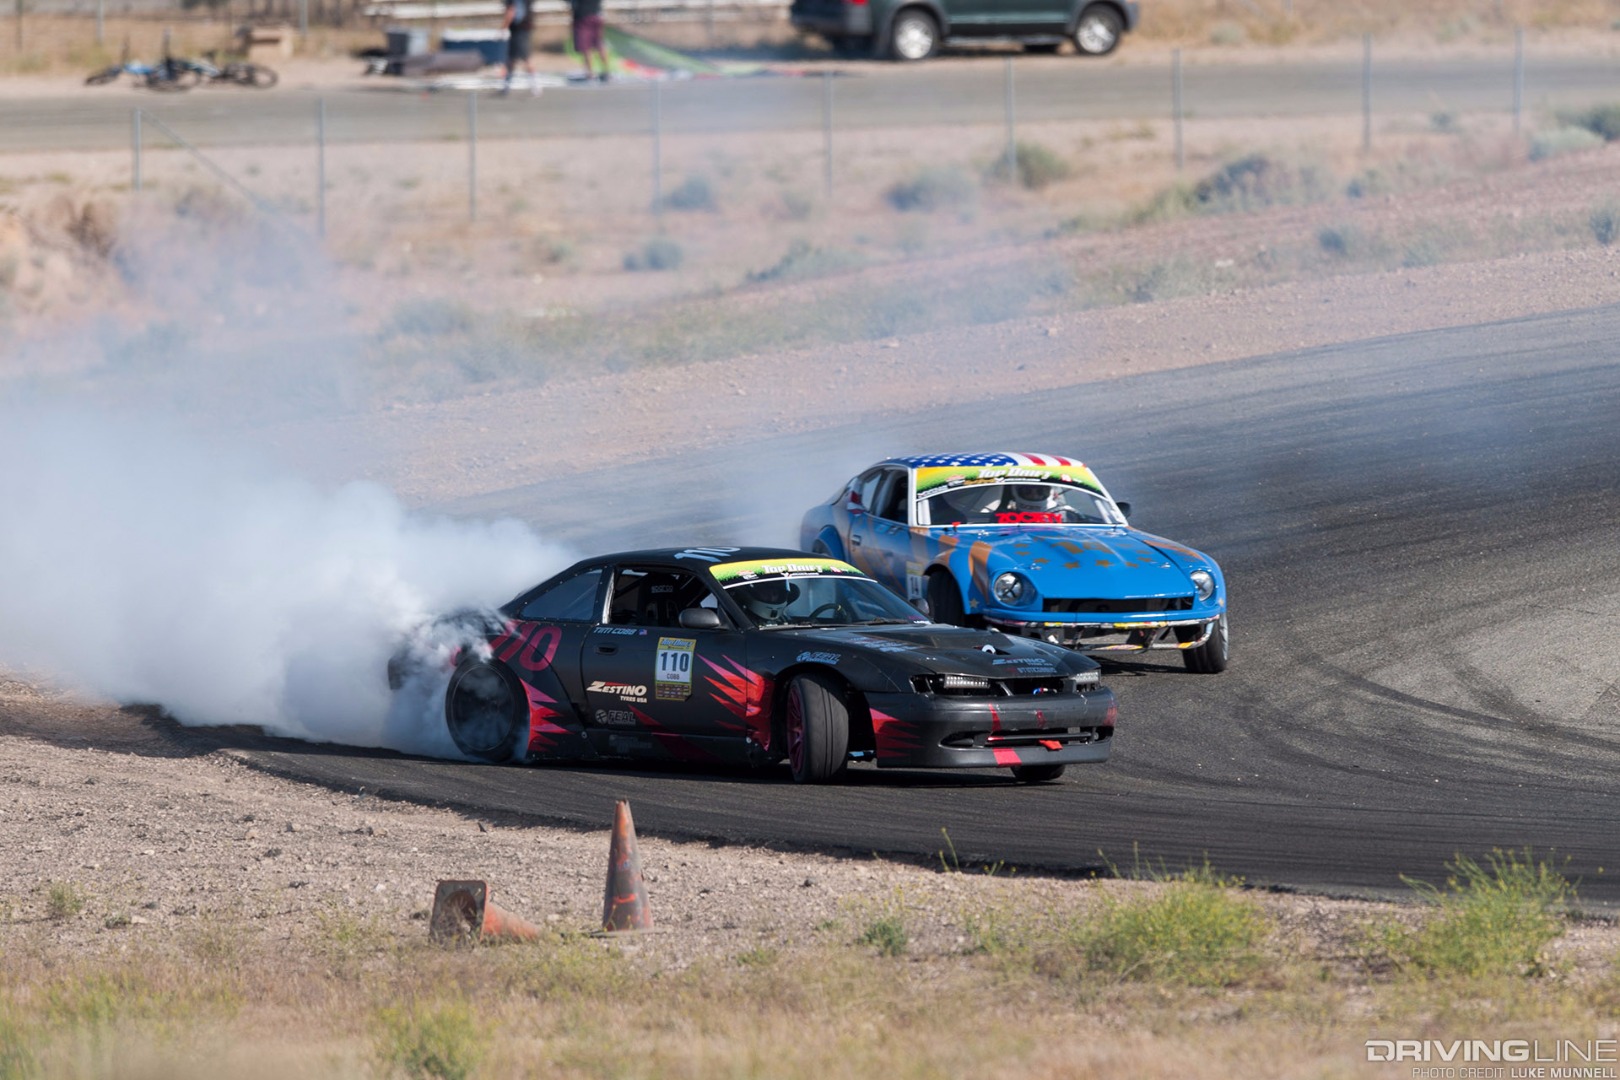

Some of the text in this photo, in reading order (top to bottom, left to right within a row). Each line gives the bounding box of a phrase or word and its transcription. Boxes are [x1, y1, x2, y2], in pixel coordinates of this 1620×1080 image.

[660, 651, 690, 672] 110
[586, 680, 647, 696] ZESTINO
[608, 710, 636, 724] FEAL
